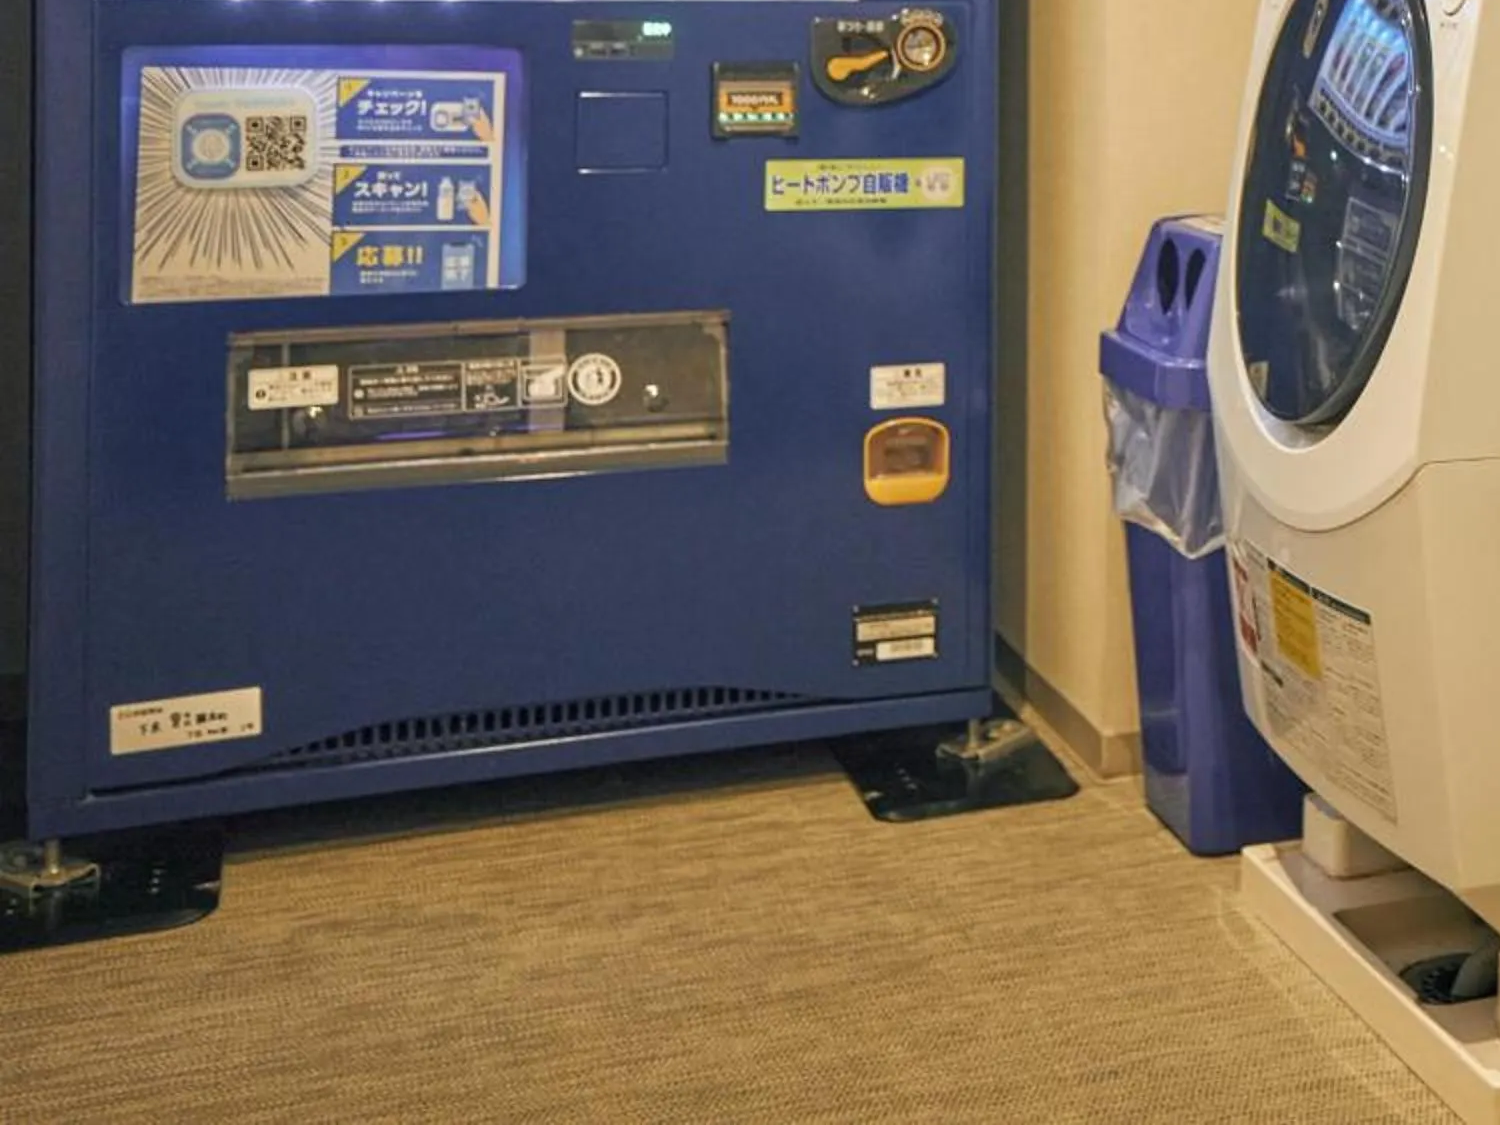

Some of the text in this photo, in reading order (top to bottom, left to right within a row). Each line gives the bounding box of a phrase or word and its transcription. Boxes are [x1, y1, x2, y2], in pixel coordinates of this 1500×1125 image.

[357, 99, 427, 117] チェック!
[353, 181, 429, 198] スキャン!
